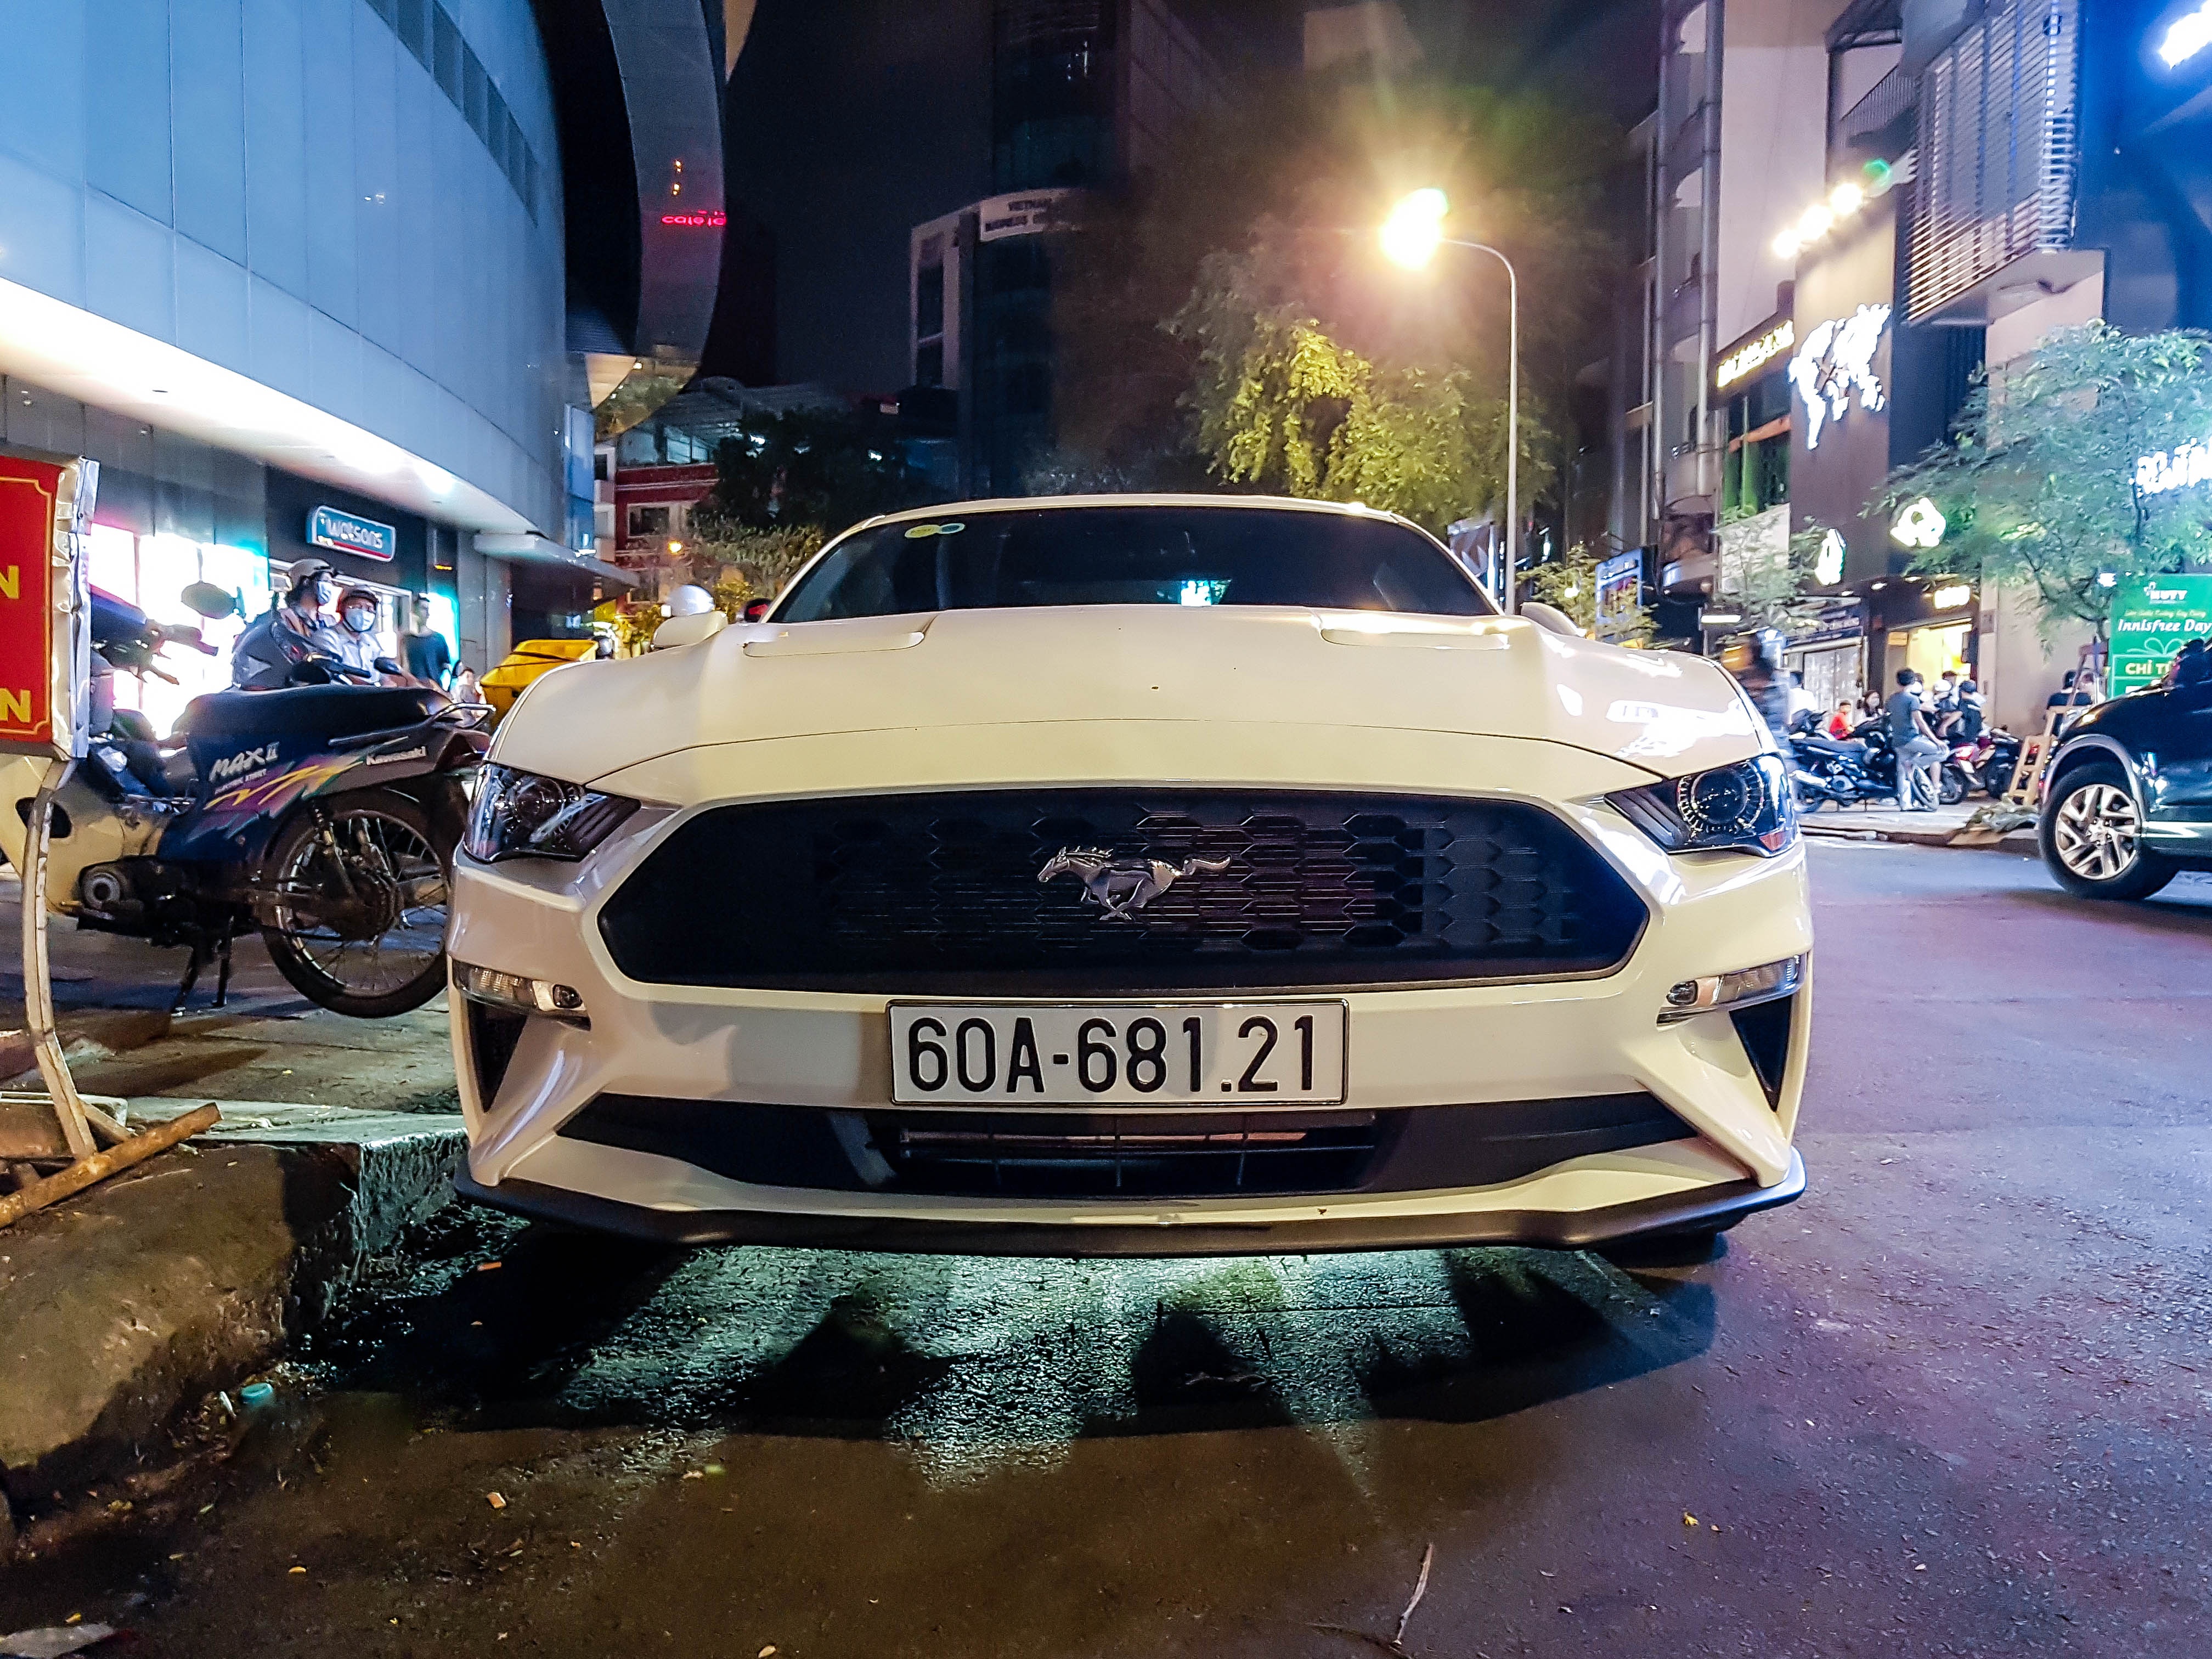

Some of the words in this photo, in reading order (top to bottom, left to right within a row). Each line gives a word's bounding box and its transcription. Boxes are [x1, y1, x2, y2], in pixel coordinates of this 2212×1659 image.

[2118, 618, 2182, 634] Innisfree
[2183, 618, 2212, 635] Day
[207, 747, 266, 783] MAX
[908, 1014, 1312, 1093] 60A-681.21
